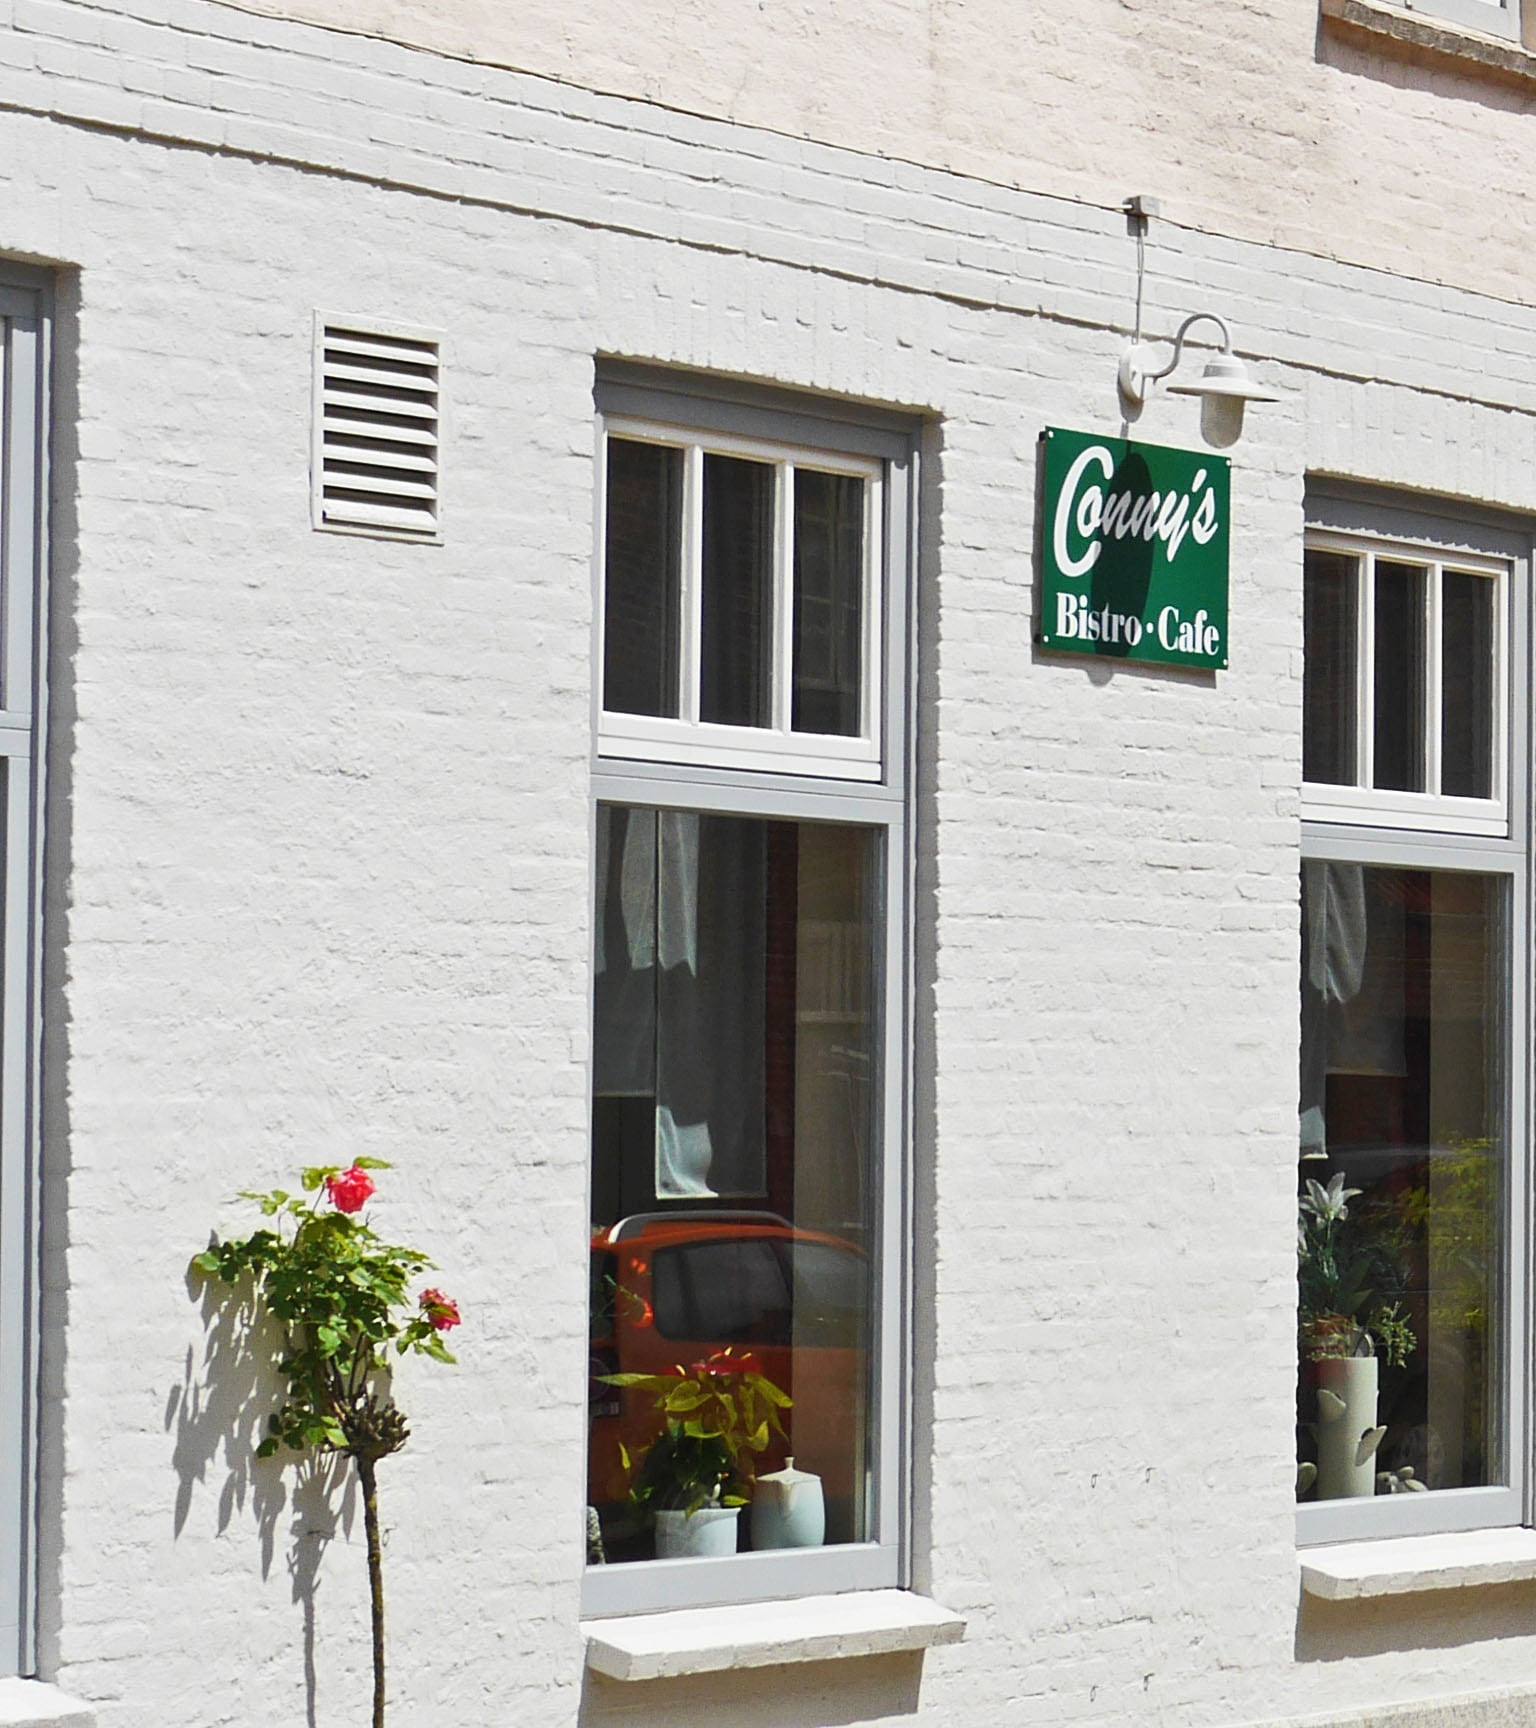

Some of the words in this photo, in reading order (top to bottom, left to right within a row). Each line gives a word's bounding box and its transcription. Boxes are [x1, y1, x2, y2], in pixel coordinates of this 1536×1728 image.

[1053, 444, 1219, 577] Conny's
[1055, 591, 1142, 646] Bistro
[1157, 605, 1220, 656] Cafe
